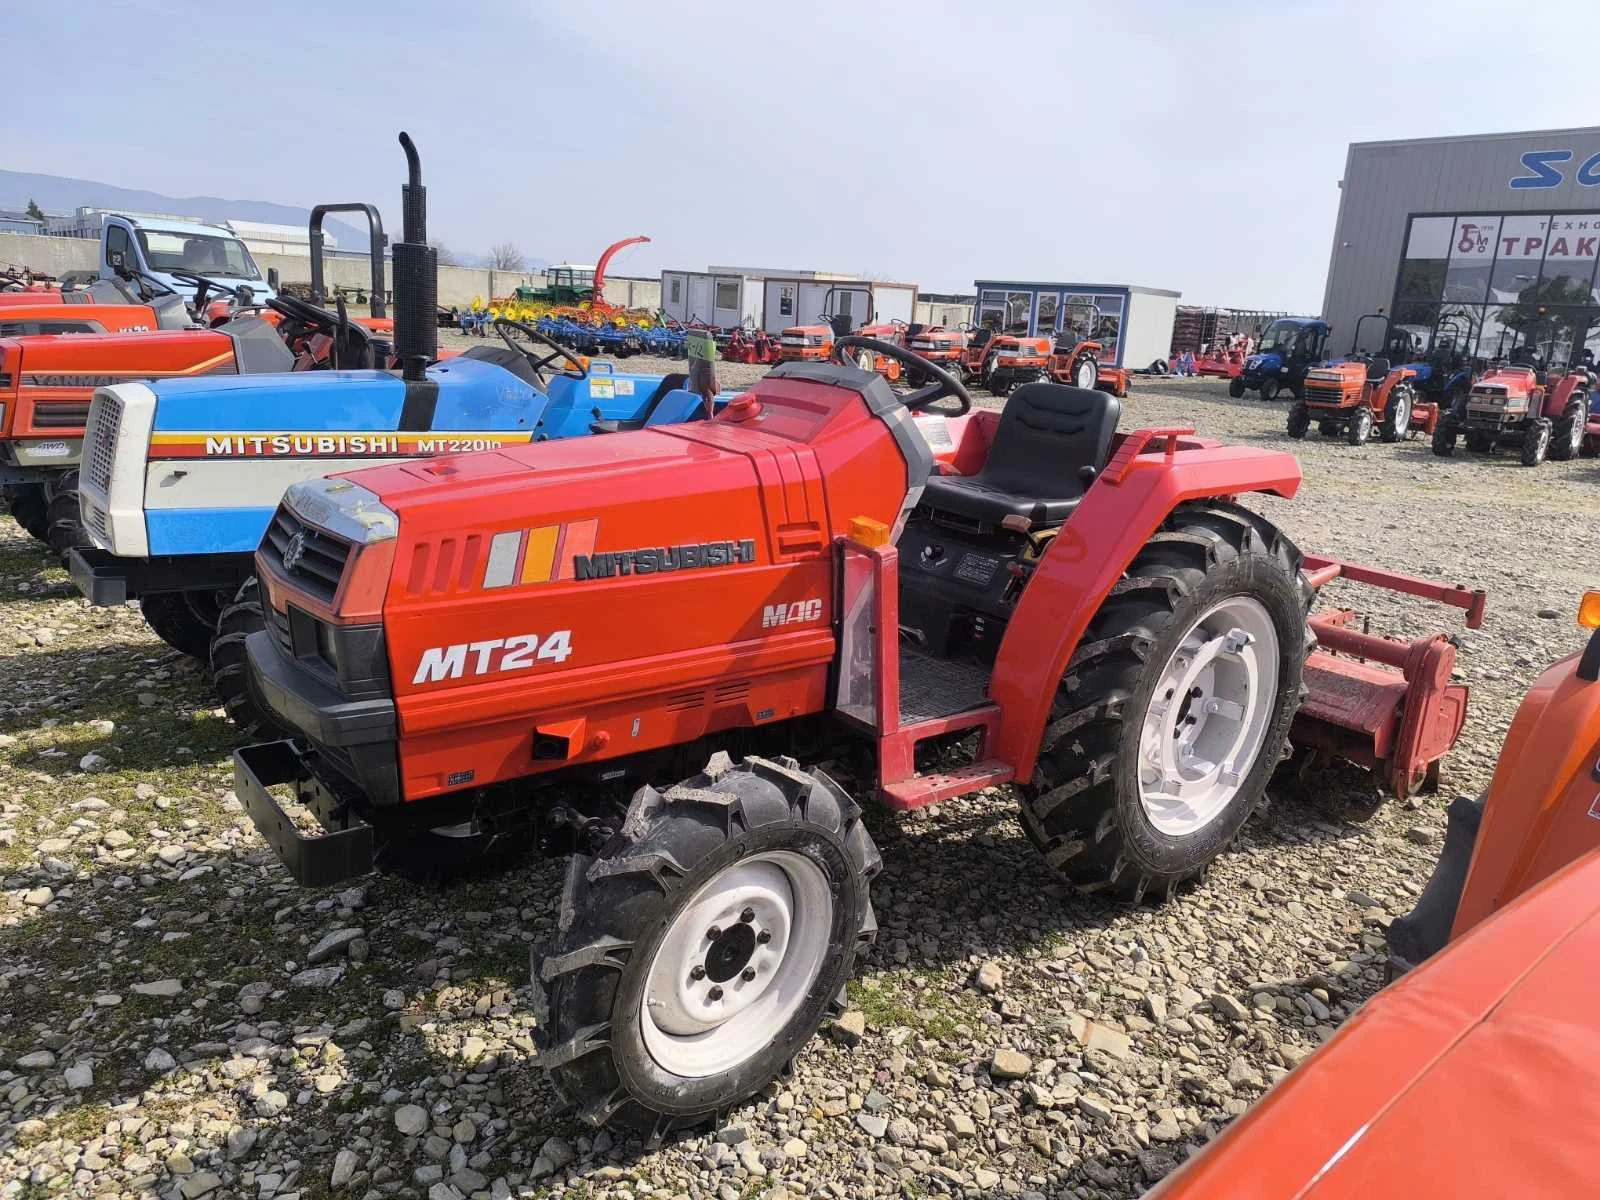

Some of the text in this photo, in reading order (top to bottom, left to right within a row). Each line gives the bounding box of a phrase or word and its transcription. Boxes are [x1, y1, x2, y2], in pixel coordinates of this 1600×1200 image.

[1502, 237, 1597, 256] ТРАК
[206, 437, 398, 455] MITSUBISHI
[574, 539, 755, 580] MITSUBISHI
[762, 598, 823, 628] MAC
[412, 630, 572, 684] MT24
